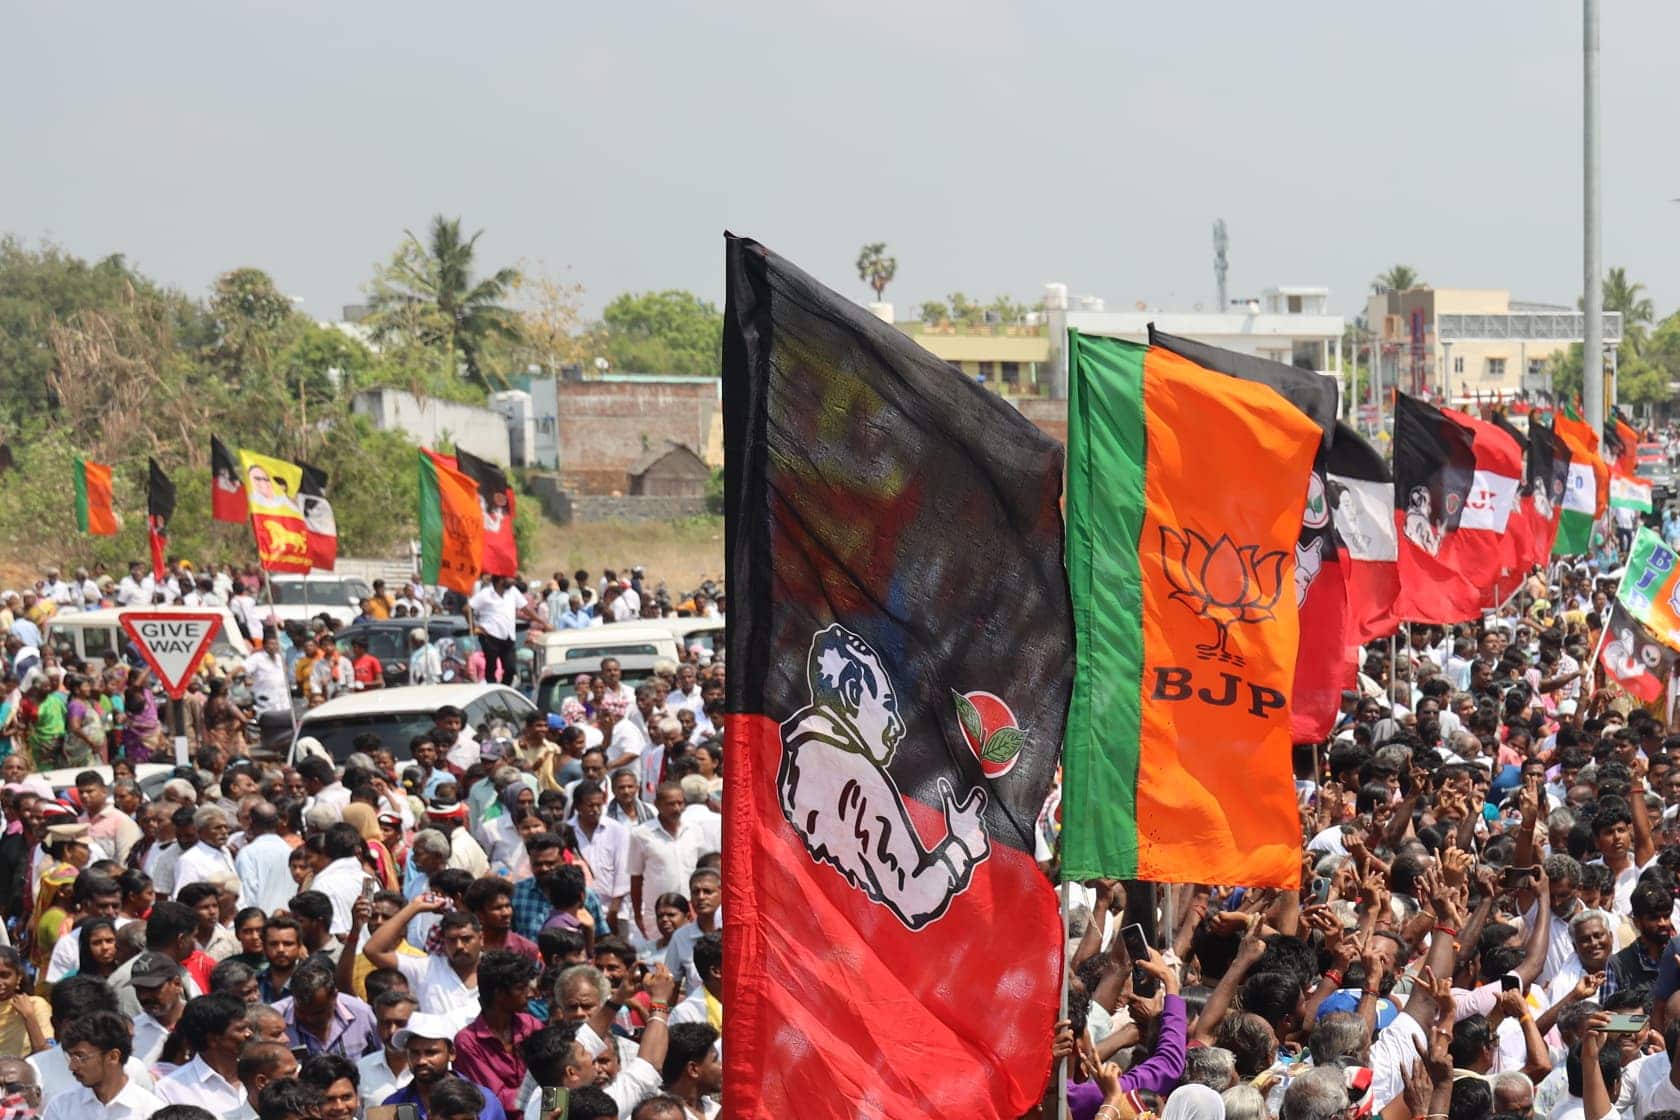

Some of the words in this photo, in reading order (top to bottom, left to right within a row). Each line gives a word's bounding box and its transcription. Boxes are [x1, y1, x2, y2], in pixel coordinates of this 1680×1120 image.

[1628, 544, 1676, 610] BJP
[141, 623, 200, 638] GIVE
[149, 640, 195, 653] WAY
[1150, 667, 1287, 719] BJP
